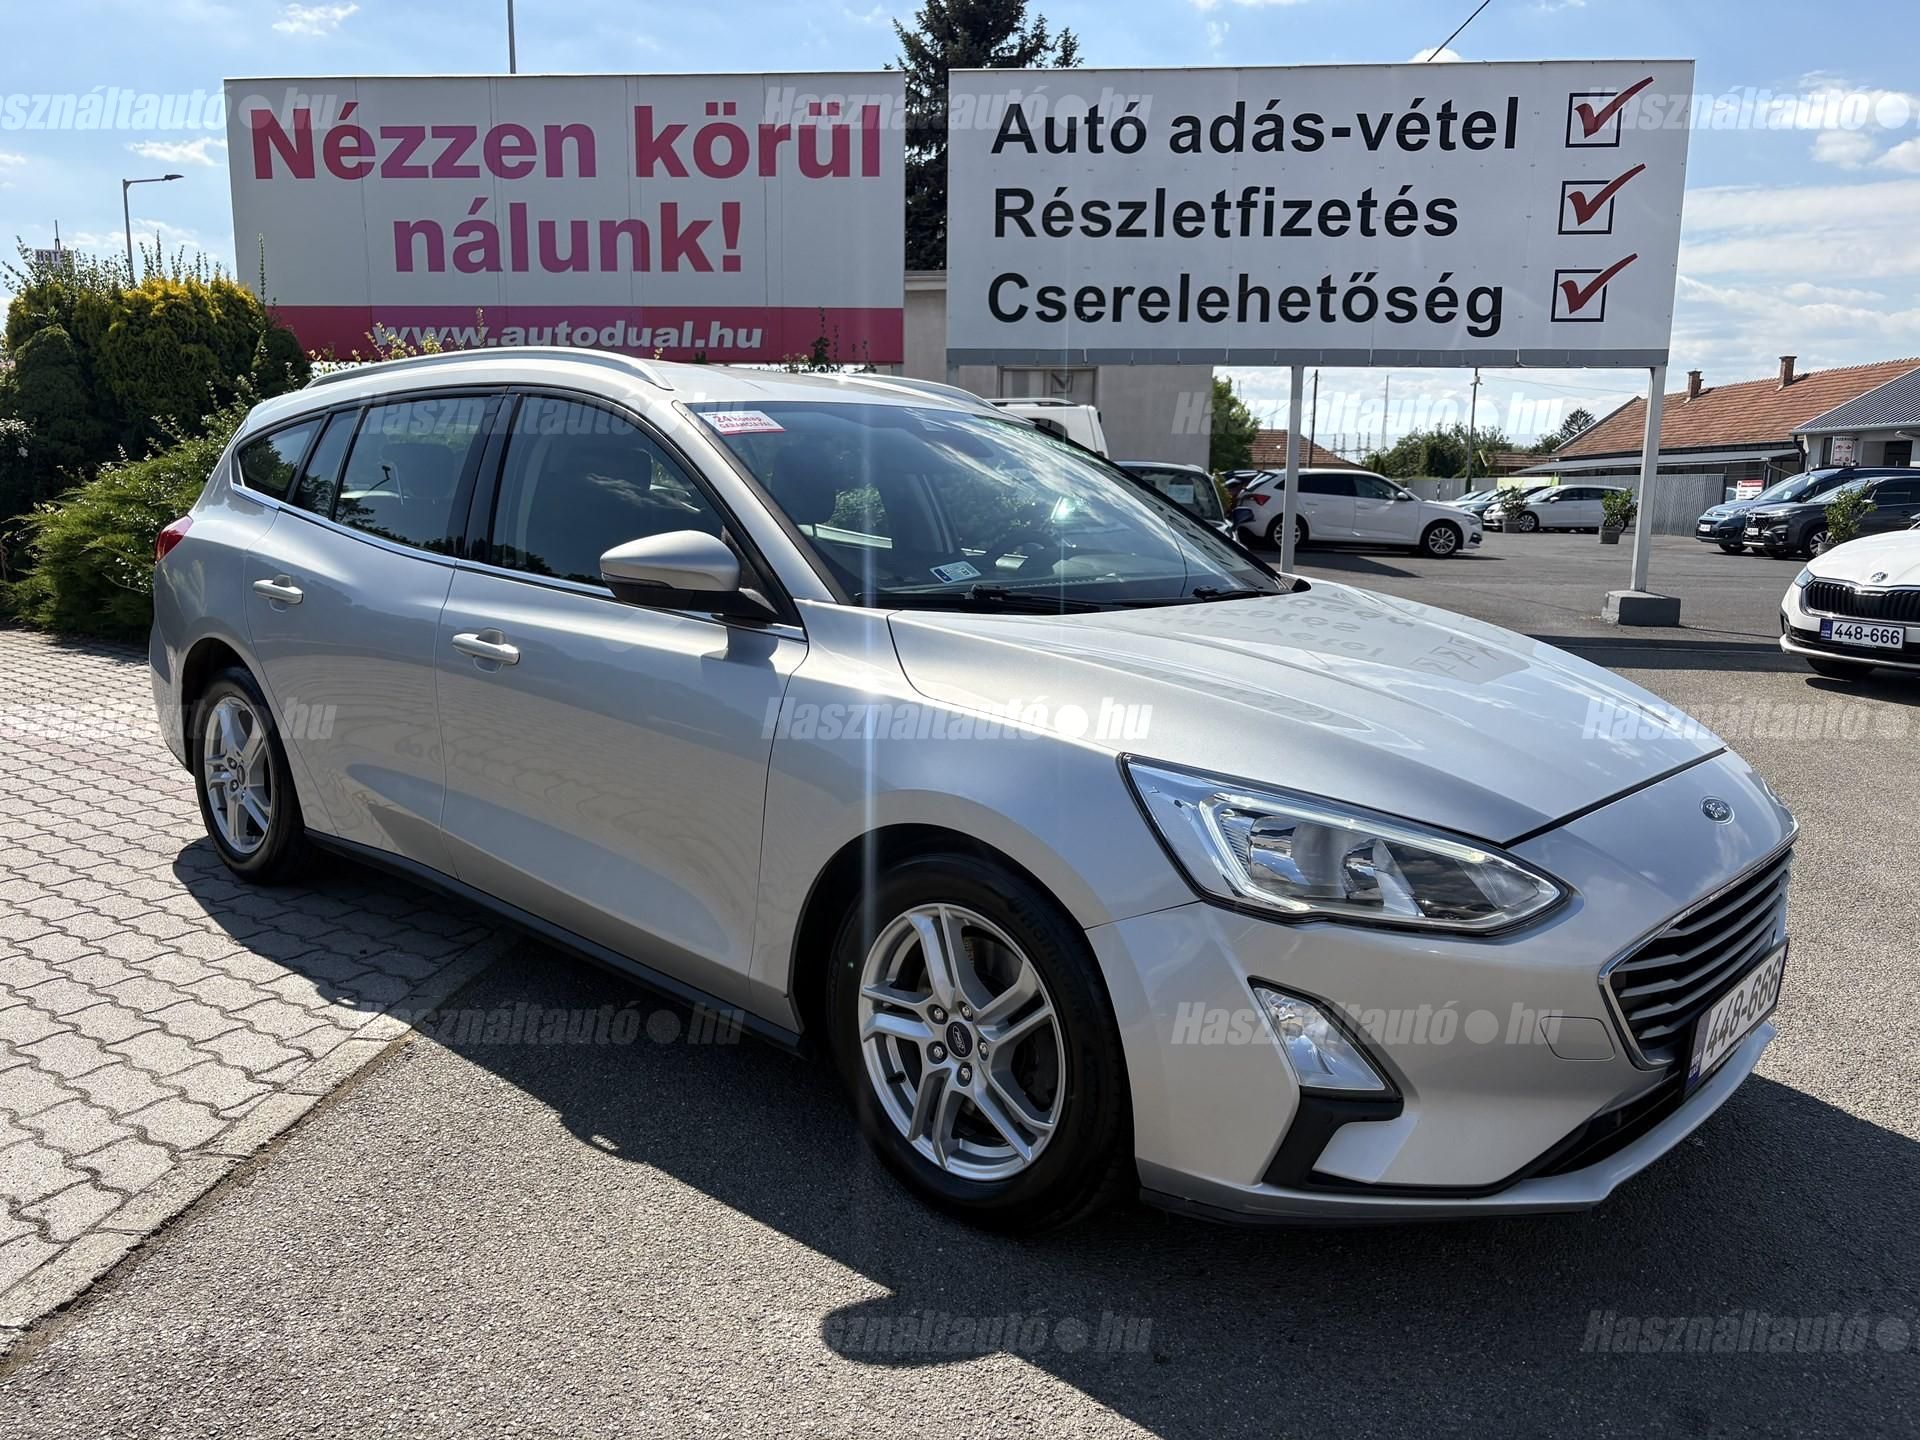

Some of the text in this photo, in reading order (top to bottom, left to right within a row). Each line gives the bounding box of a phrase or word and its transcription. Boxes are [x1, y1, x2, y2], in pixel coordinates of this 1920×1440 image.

[250, 101, 881, 180] Nézzen körül
[991, 96, 1518, 154] Autó adás-vétel
[394, 197, 741, 273] nálunk!
[994, 184, 1458, 238] Részletfizetés
[372, 320, 763, 348] www.autodual.hu
[988, 272, 1503, 337] Cserelehetőség
[1834, 623, 1900, 645] 448-666
[1706, 956, 1781, 1058] 448-666
